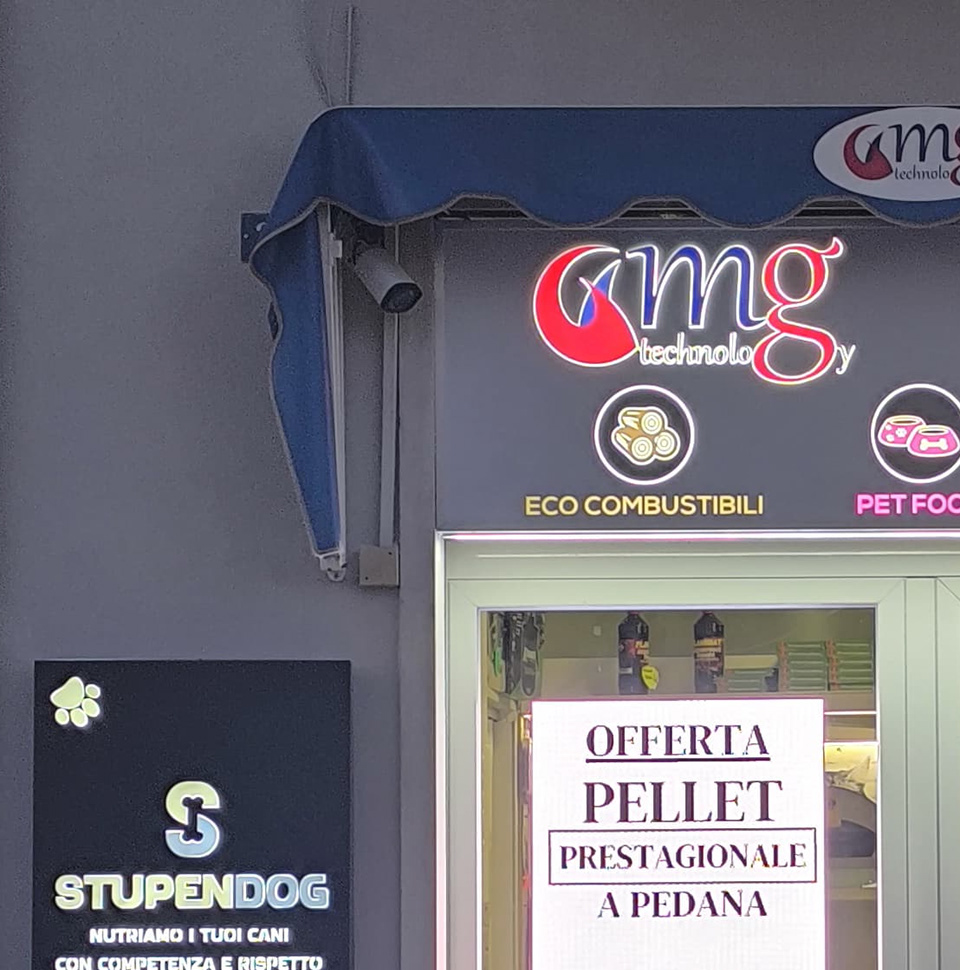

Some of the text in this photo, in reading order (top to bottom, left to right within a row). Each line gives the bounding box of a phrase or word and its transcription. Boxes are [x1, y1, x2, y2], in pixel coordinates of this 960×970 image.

[525, 495, 764, 515] ECO COMBUSTIBILI
[856, 494, 908, 515] PET
[586, 724, 771, 757] OFFERTA
[583, 780, 784, 824] PELLET
[560, 842, 808, 870] PRESTAGIONALE
[54, 873, 331, 910] STUPENDOG
[597, 889, 768, 918] A PEDANA
[89, 927, 290, 944] NUTRIAMO I TUOI CANI
[220, 956, 233, 970] E
